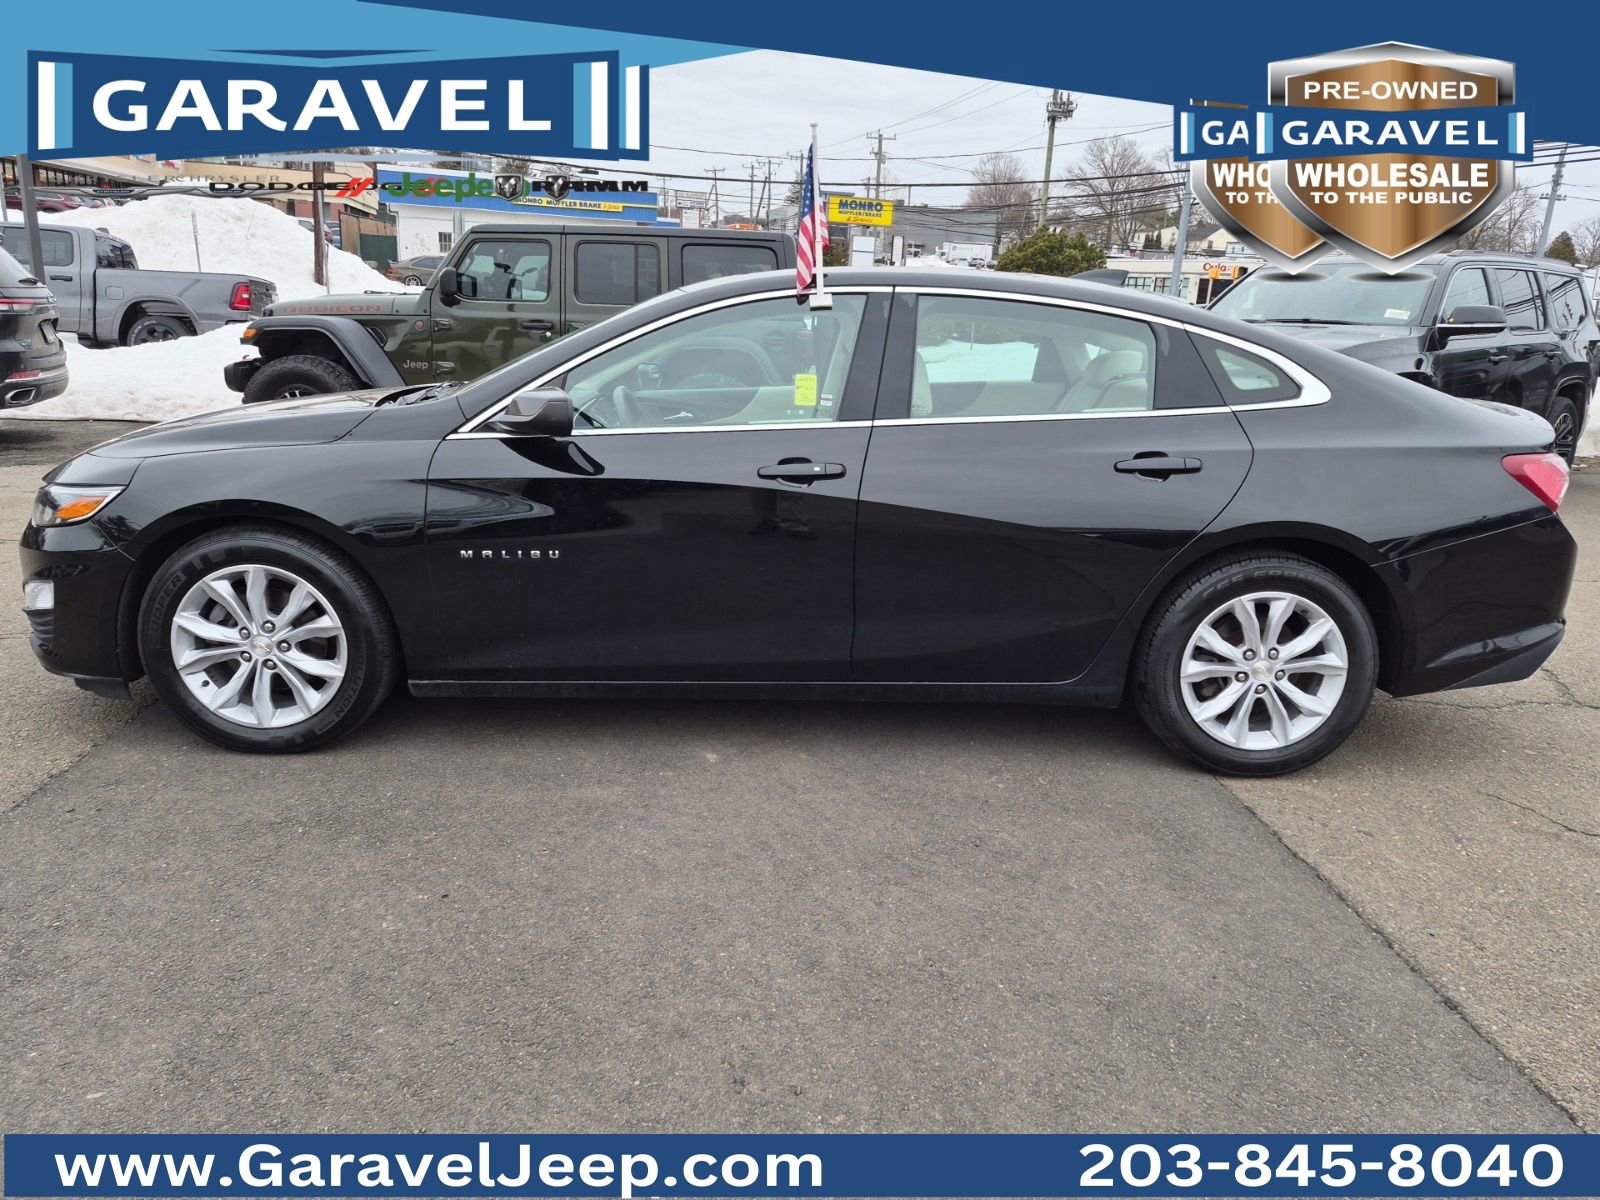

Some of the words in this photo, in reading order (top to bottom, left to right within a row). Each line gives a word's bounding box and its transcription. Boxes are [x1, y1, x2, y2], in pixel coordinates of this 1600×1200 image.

[839, 199, 884, 212] MONRO
[284, 304, 384, 313] RUBICON
[403, 359, 429, 370] Jeep
[459, 550, 560, 559] MALIBU
